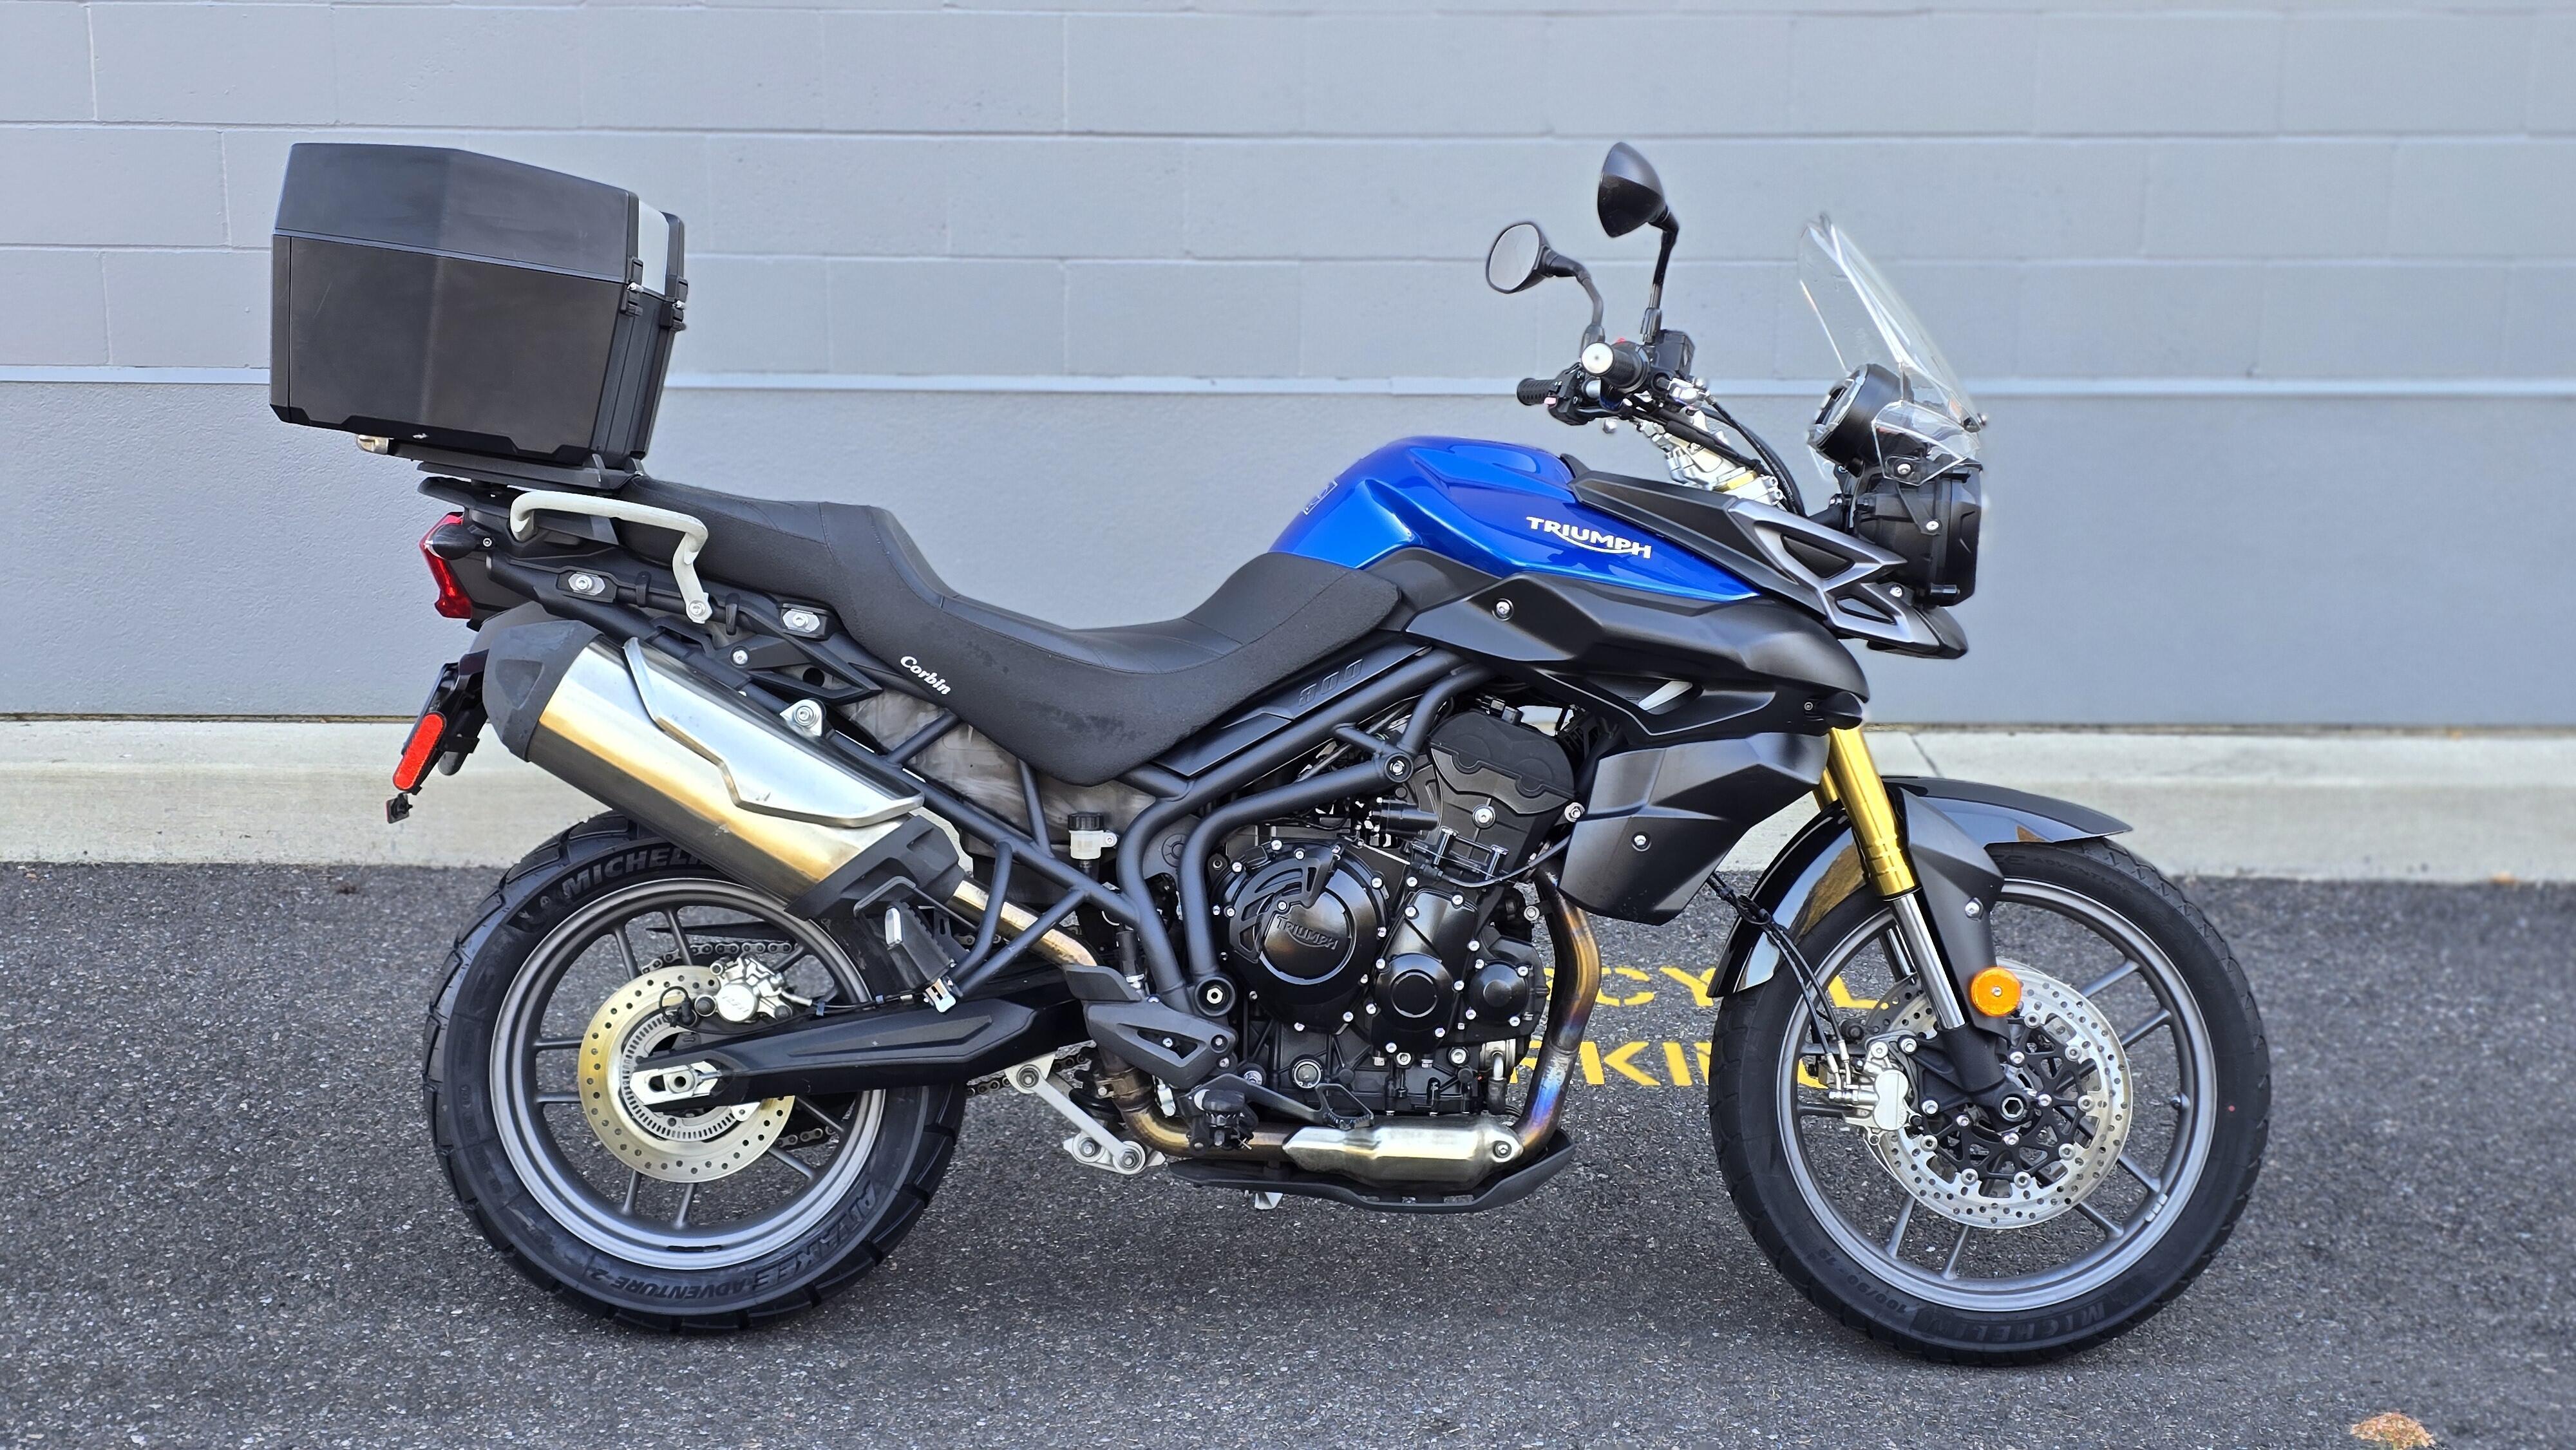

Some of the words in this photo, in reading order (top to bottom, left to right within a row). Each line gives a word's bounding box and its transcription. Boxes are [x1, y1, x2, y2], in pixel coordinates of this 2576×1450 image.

[1526, 516, 1651, 559] TRIUMPH
[900, 656, 951, 695] Corbin
[1298, 659, 1363, 707] 800
[561, 847, 707, 899] MICHEL
[1277, 915, 1338, 950] TRIUMPH
[755, 1180, 878, 1287] ANAKEE
[609, 1275, 750, 1300] ADVENTURE
